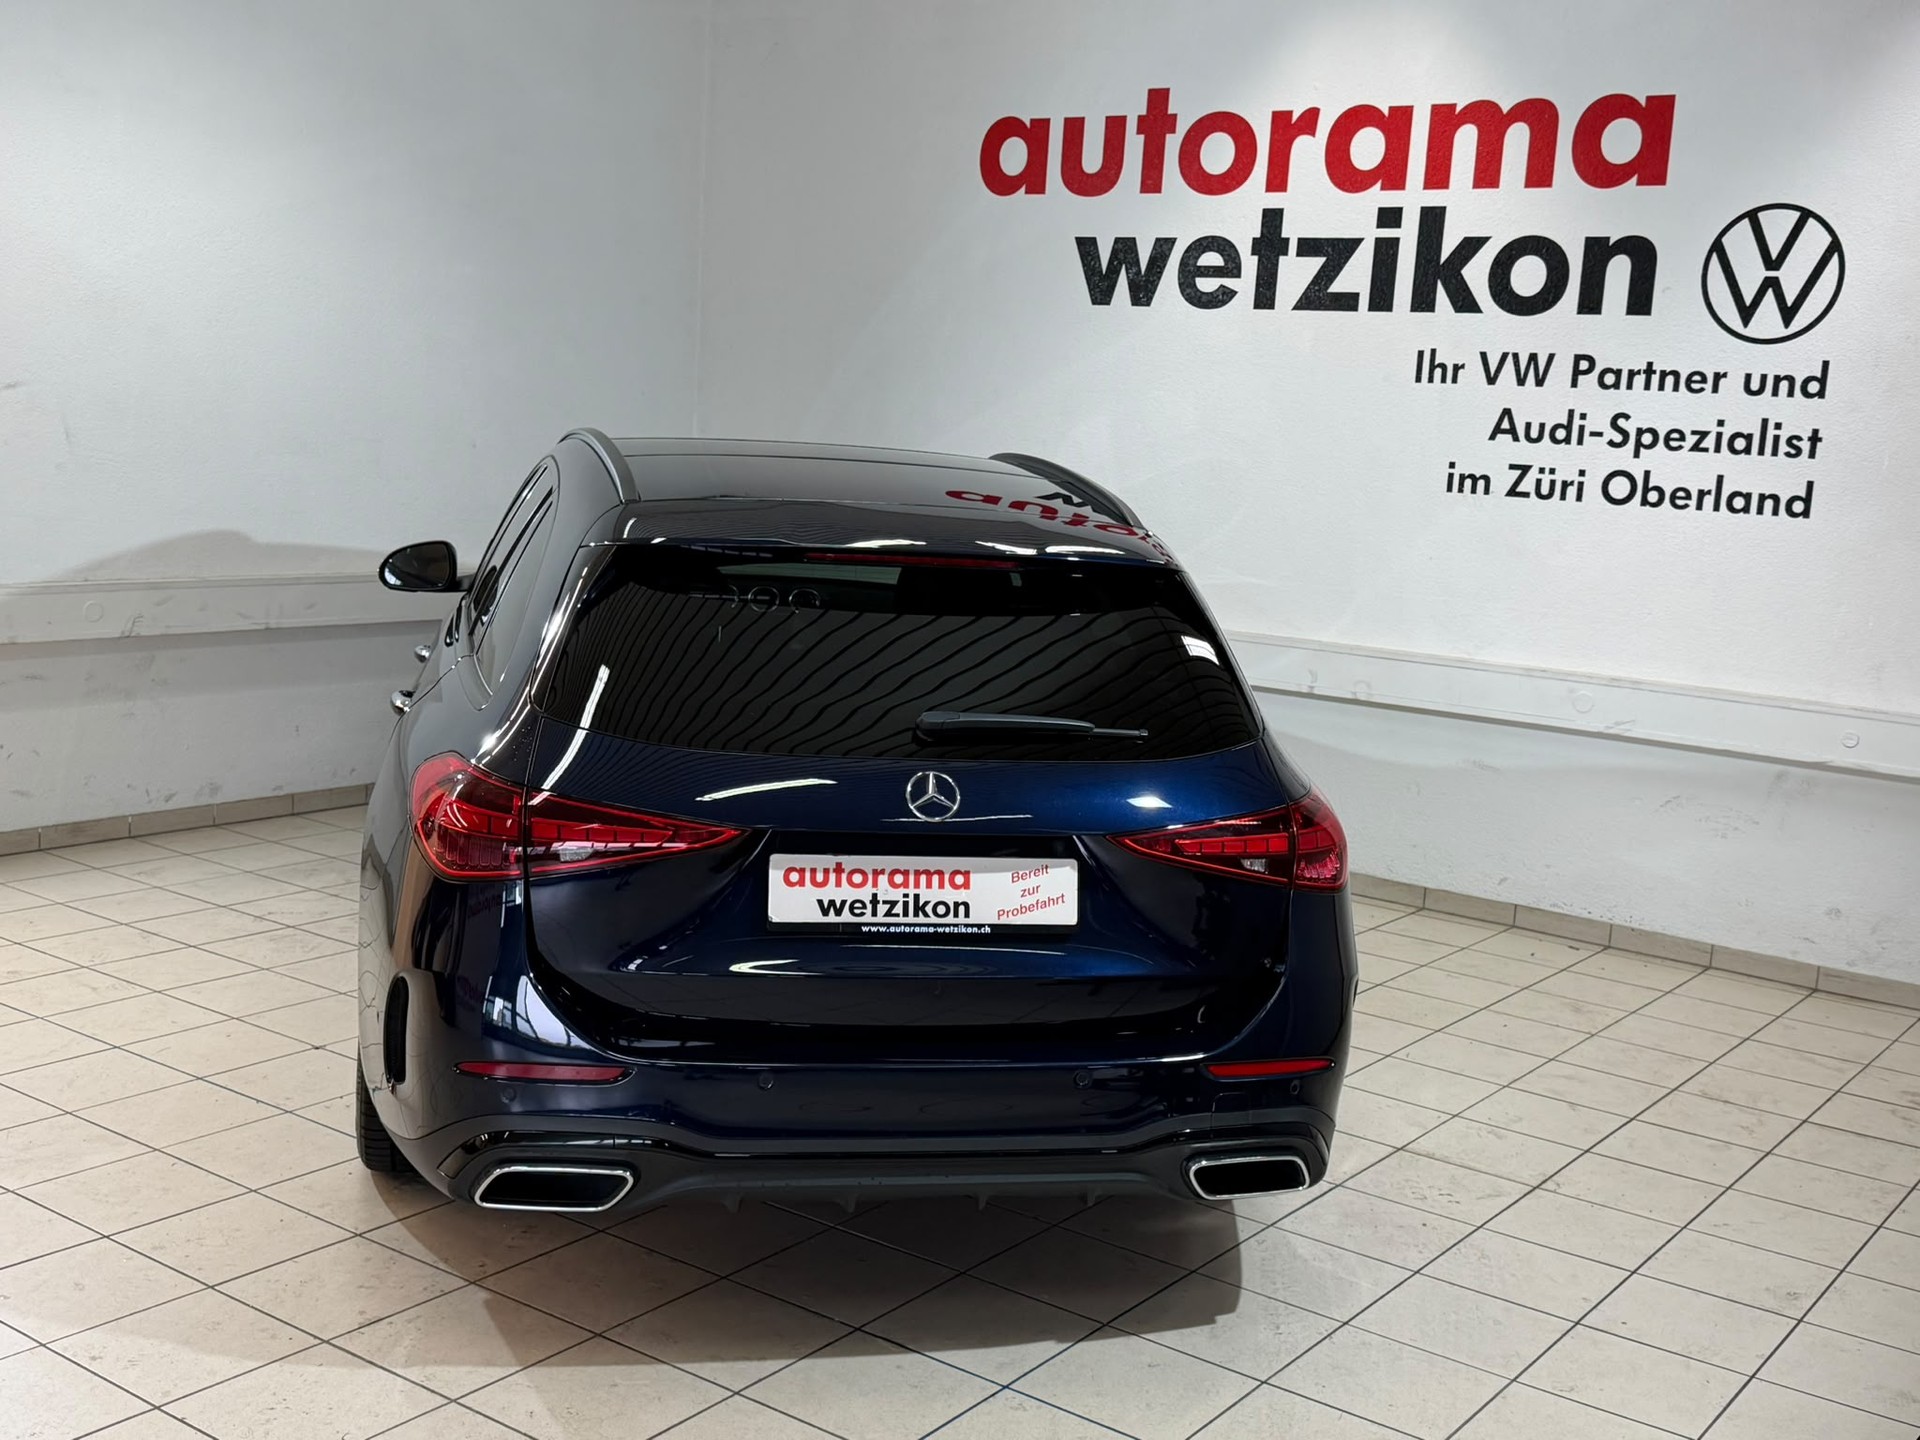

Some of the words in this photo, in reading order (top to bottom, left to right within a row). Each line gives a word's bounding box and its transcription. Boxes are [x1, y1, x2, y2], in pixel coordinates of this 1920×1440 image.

[979, 88, 1677, 198] autorama
[1074, 205, 1658, 317] wetzikon
[1414, 349, 1465, 385] Ihr
[1479, 352, 1556, 388] VW
[1570, 354, 1728, 394] Partner
[1743, 360, 1830, 400] und
[1488, 407, 1823, 461] Audi-Spezialist
[1446, 461, 1491, 496] im
[1504, 463, 1586, 503] Züri
[1601, 470, 1815, 520] Oberland
[783, 861, 971, 890] autorama
[1011, 864, 1050, 884] Bereit
[816, 892, 971, 919] wetzikon
[1019, 883, 1042, 899] zur
[996, 893, 1066, 920] Probefahrt
[861, 924, 991, 934] www.autorama-wetzikon.ch
